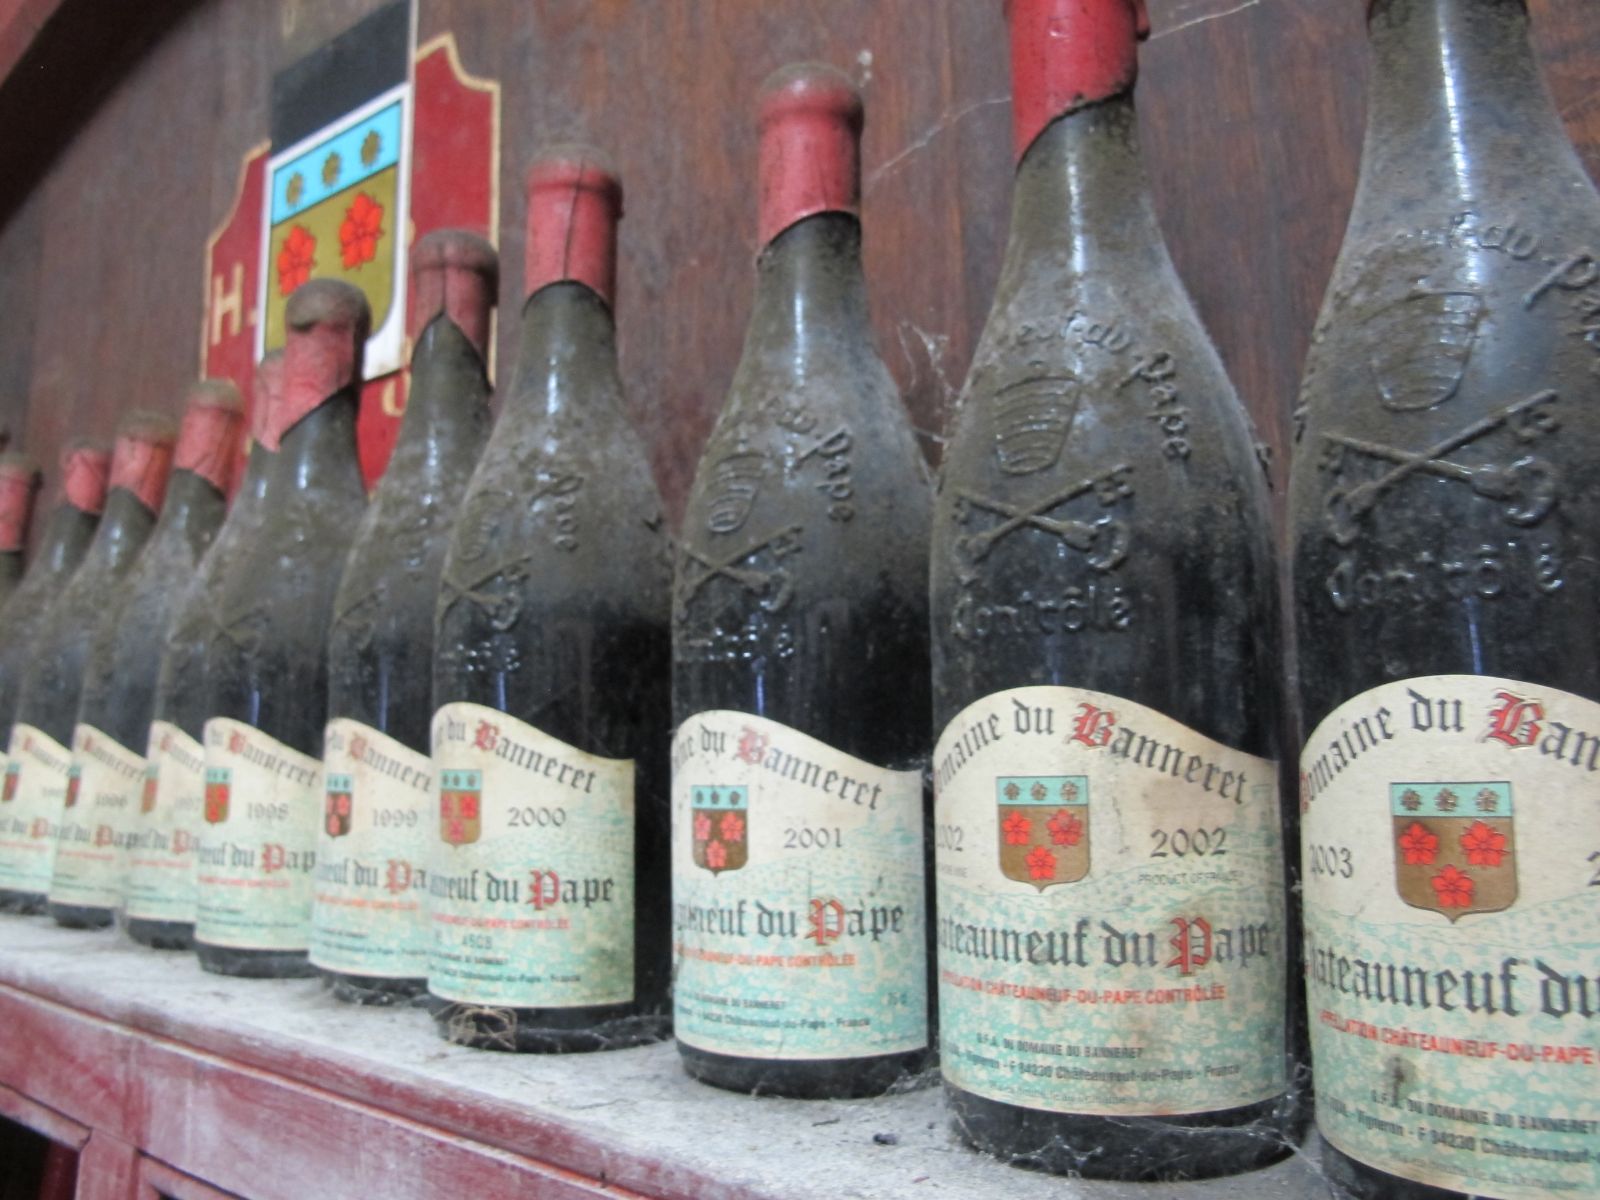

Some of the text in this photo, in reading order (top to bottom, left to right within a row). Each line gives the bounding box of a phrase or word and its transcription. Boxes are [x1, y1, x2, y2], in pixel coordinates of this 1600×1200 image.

[1405, 687, 1465, 733] du
[472, 718, 597, 794] Banneret
[734, 724, 882, 811] Banneret
[1011, 697, 1055, 736] du
[1065, 702, 1247, 806] Banneret
[507, 806, 567, 828] 2000
[783, 827, 844, 849] 2001
[1149, 827, 1228, 858] 2002
[486, 871, 521, 904] du
[526, 868, 615, 912] Pape
[756, 900, 799, 938] du
[804, 896, 905, 947] Pape
[1101, 919, 1159, 967] du
[1164, 916, 1271, 977] Pape
